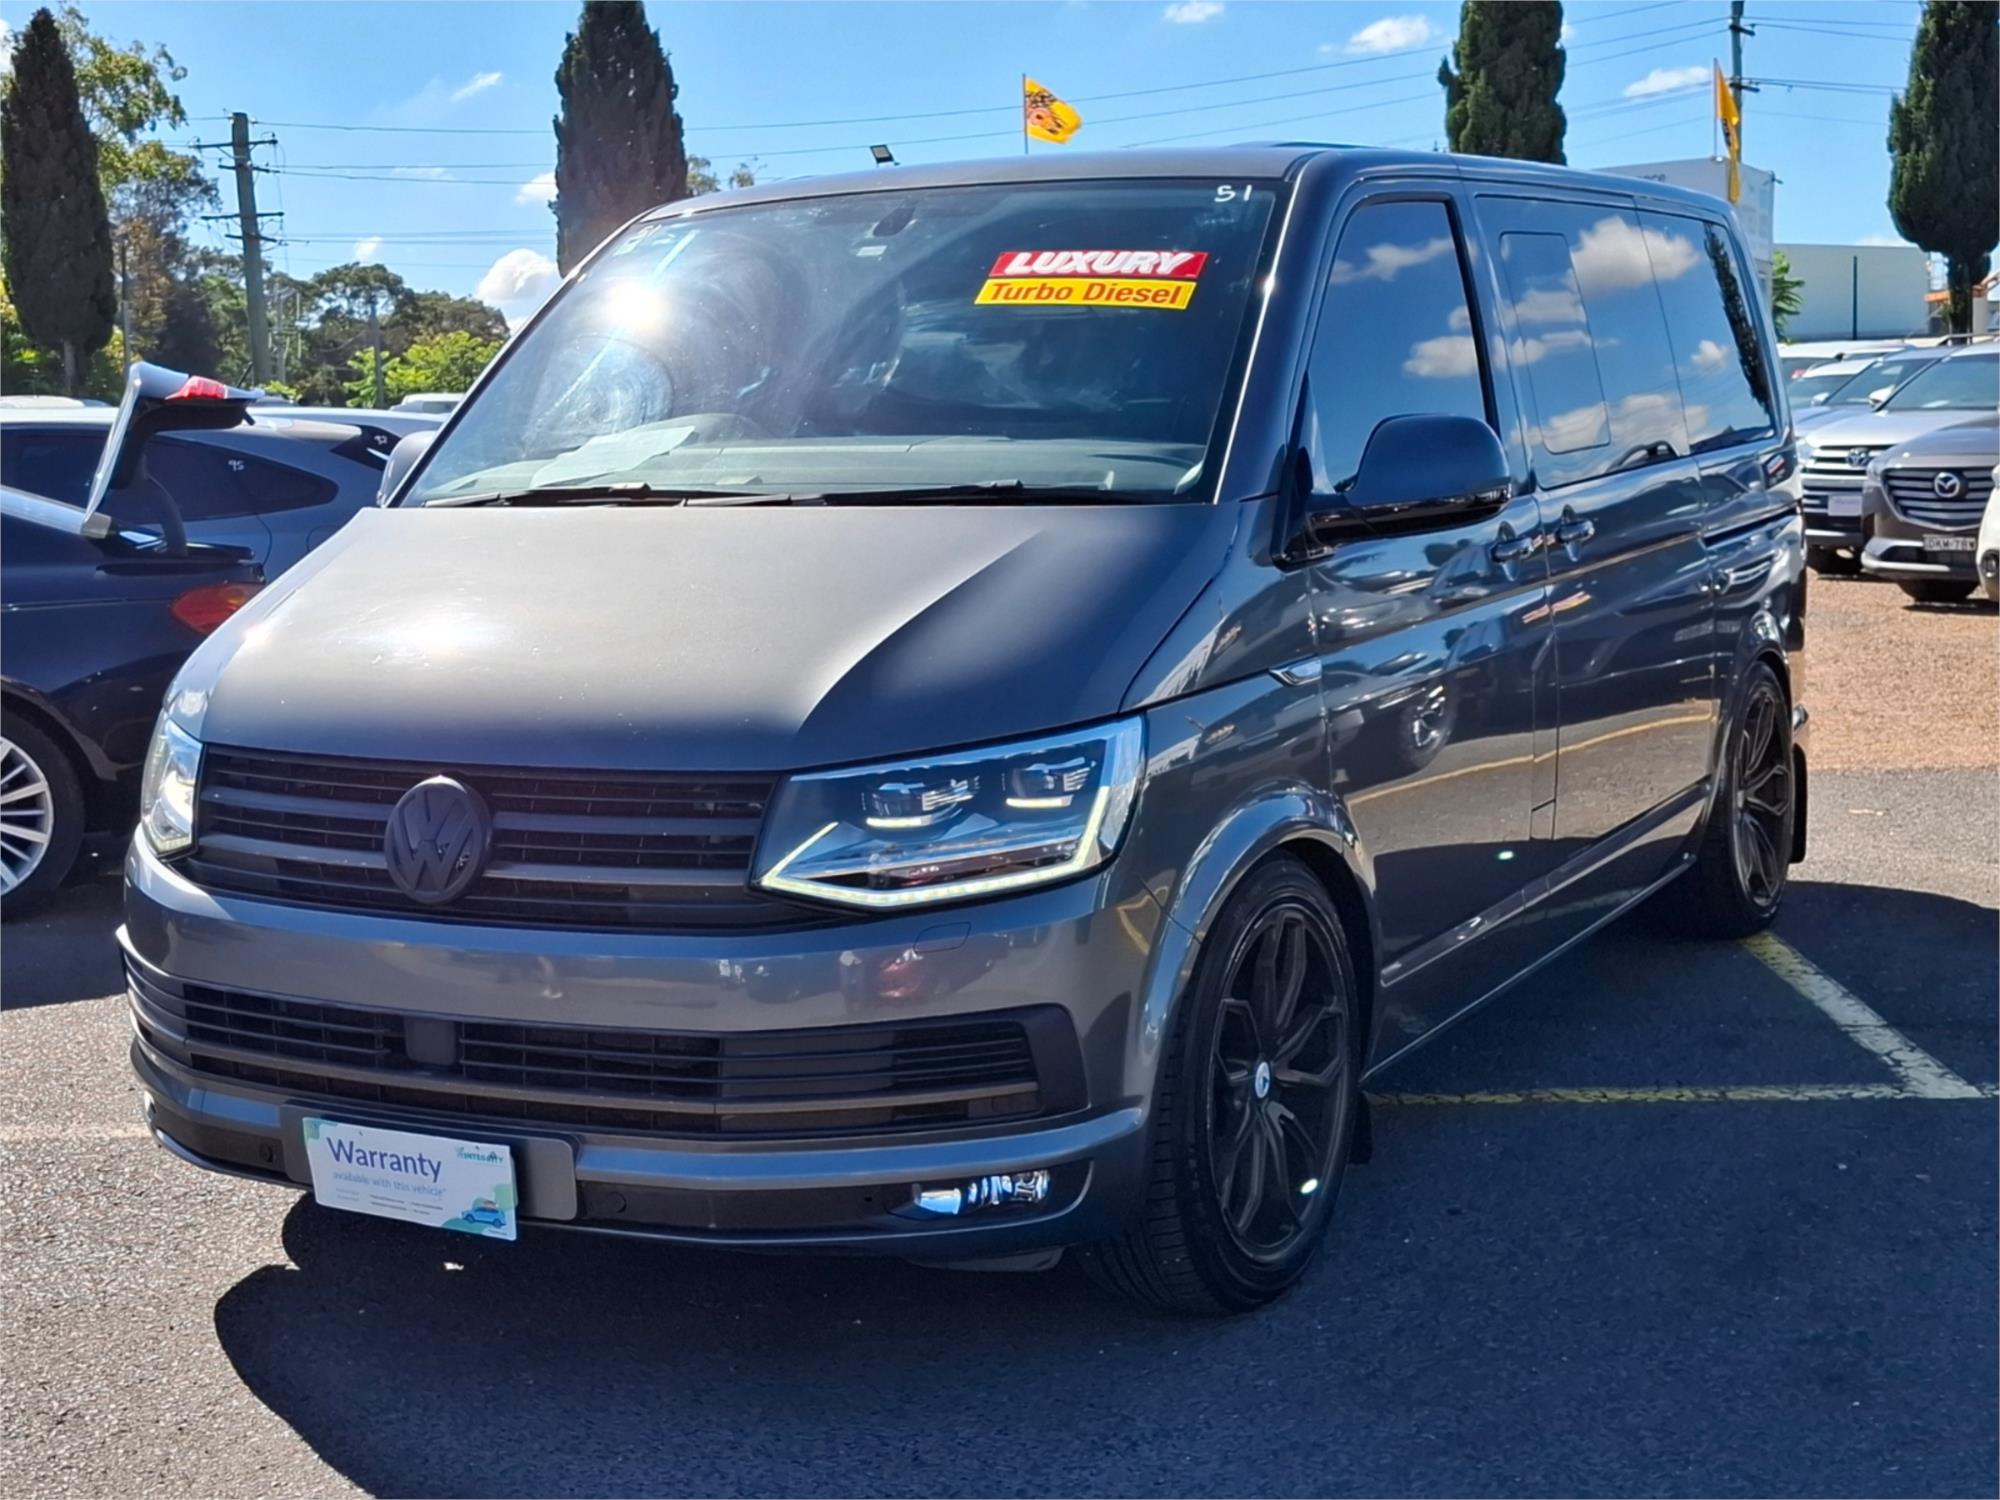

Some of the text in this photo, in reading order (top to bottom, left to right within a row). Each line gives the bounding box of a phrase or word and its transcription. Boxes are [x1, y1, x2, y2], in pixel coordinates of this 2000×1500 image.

[1004, 252, 1194, 275] LUXURY
[991, 282, 1182, 305] Turbo Diesel
[228, 459, 245, 472] 95
[326, 1137, 442, 1183] Warranty
